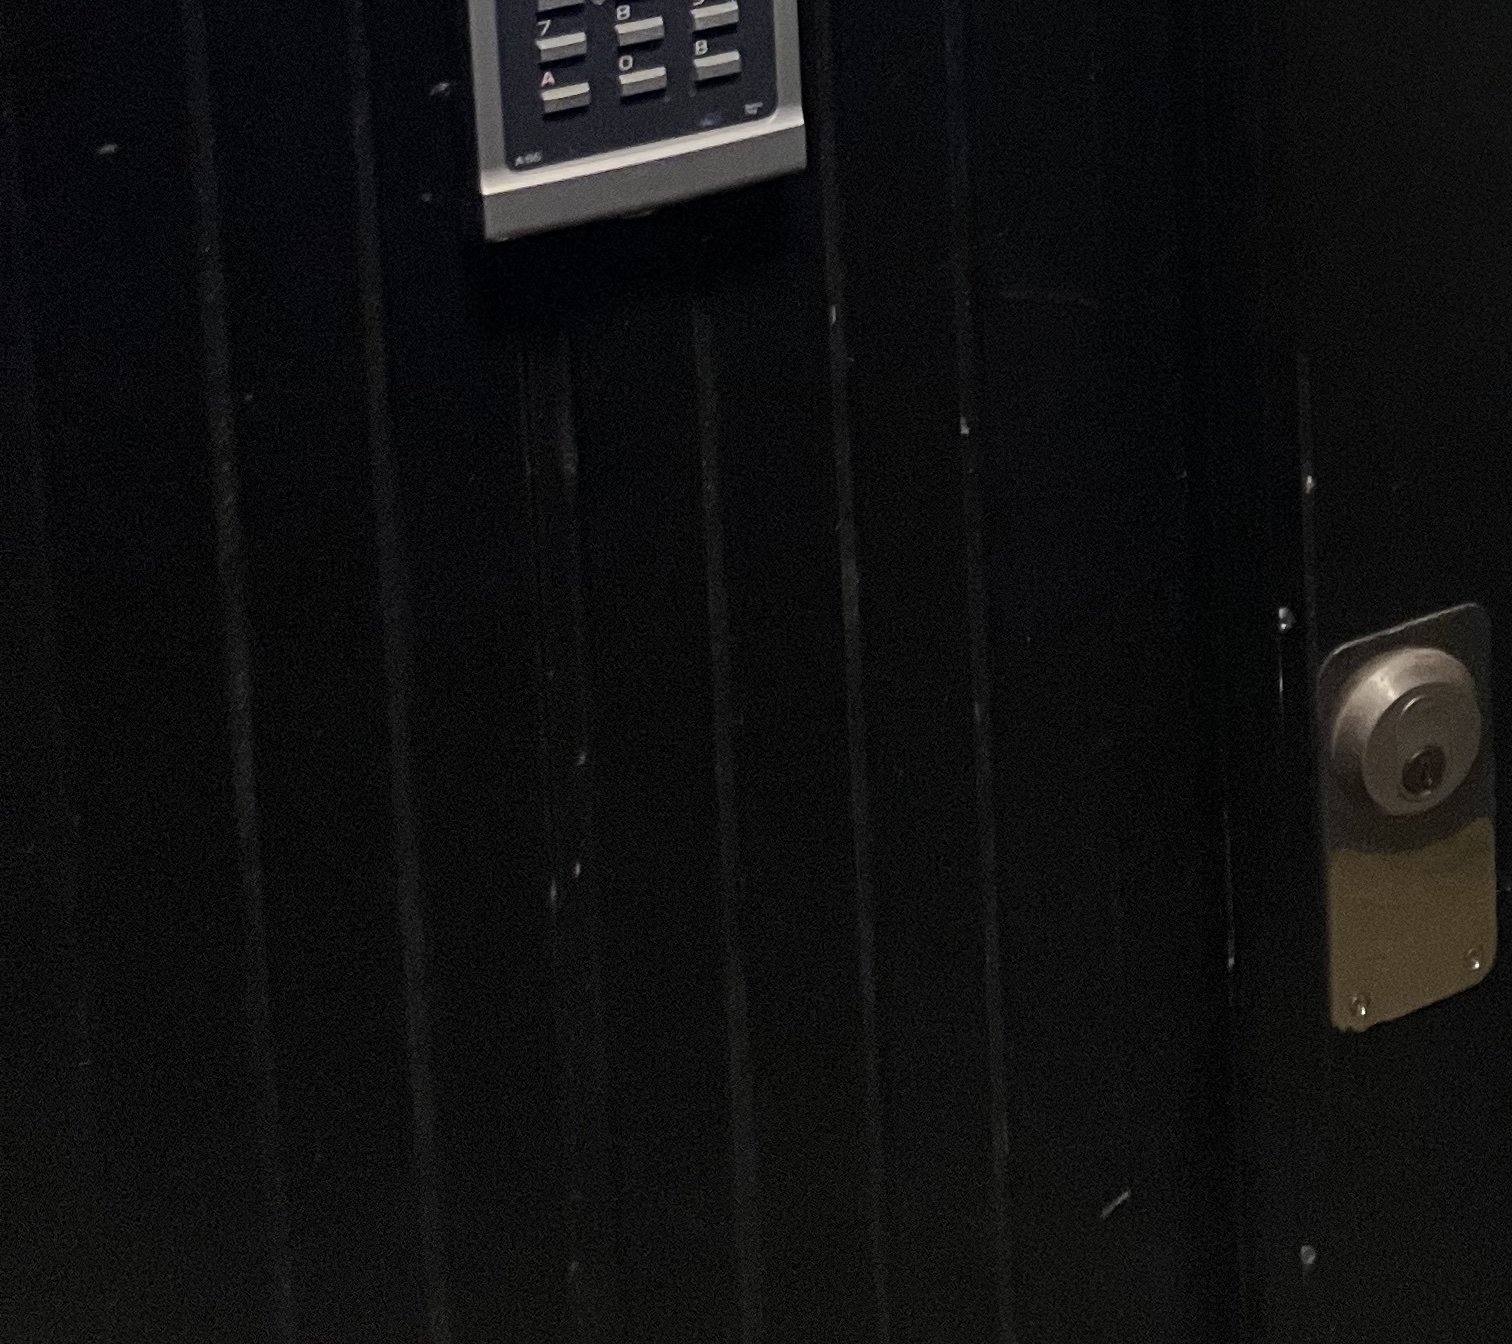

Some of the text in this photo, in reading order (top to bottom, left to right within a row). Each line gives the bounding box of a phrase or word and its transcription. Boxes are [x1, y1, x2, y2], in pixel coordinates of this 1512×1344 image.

[537, 19, 551, 35] 7
[616, 4, 631, 20] 8
[541, 71, 555, 87] A
[695, 39, 708, 56] B
